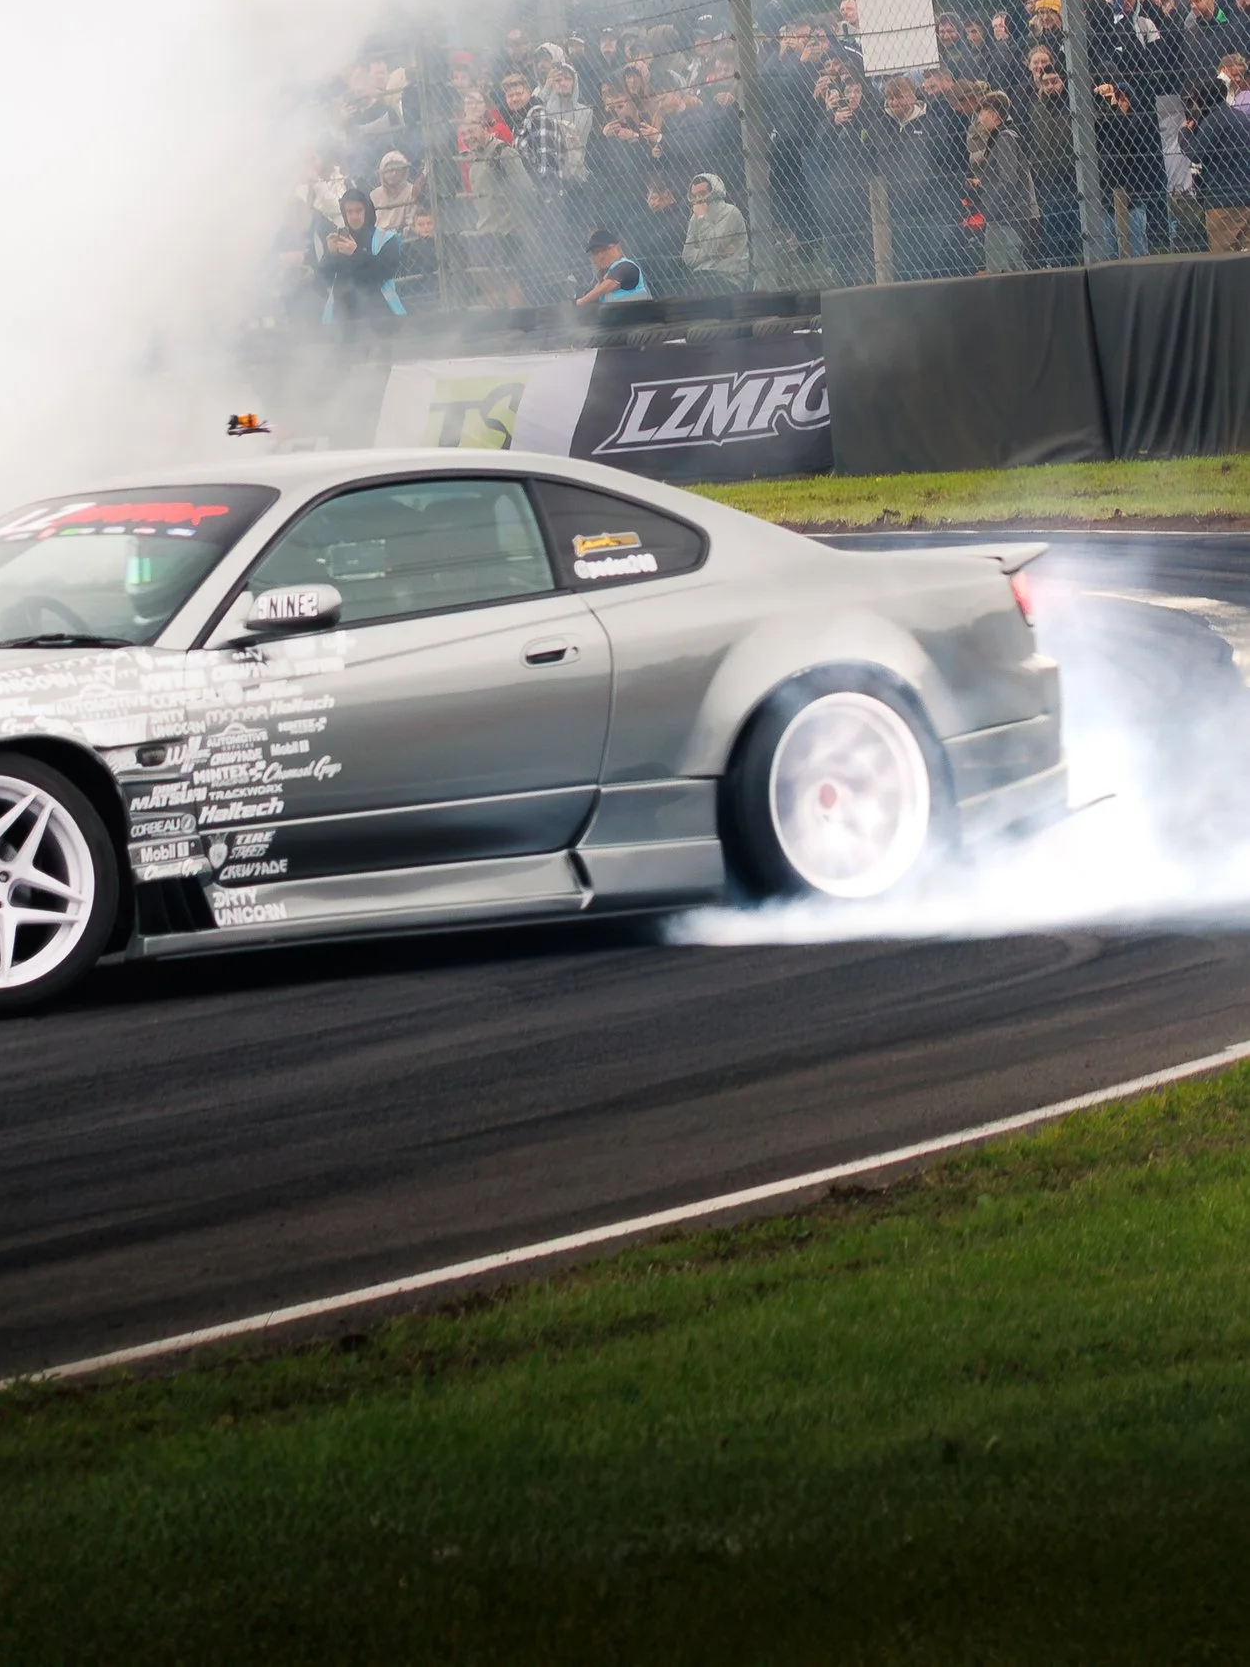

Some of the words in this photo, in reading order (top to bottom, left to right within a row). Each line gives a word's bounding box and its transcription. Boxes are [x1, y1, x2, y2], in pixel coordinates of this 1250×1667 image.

[209, 784, 283, 801] TRACKWORX
[199, 797, 285, 825] Haltech
[131, 818, 181, 838] CORBEAU
[140, 842, 176, 864] Mobil
[211, 888, 258, 908] DIRTY
[214, 902, 288, 928] UNICORN
